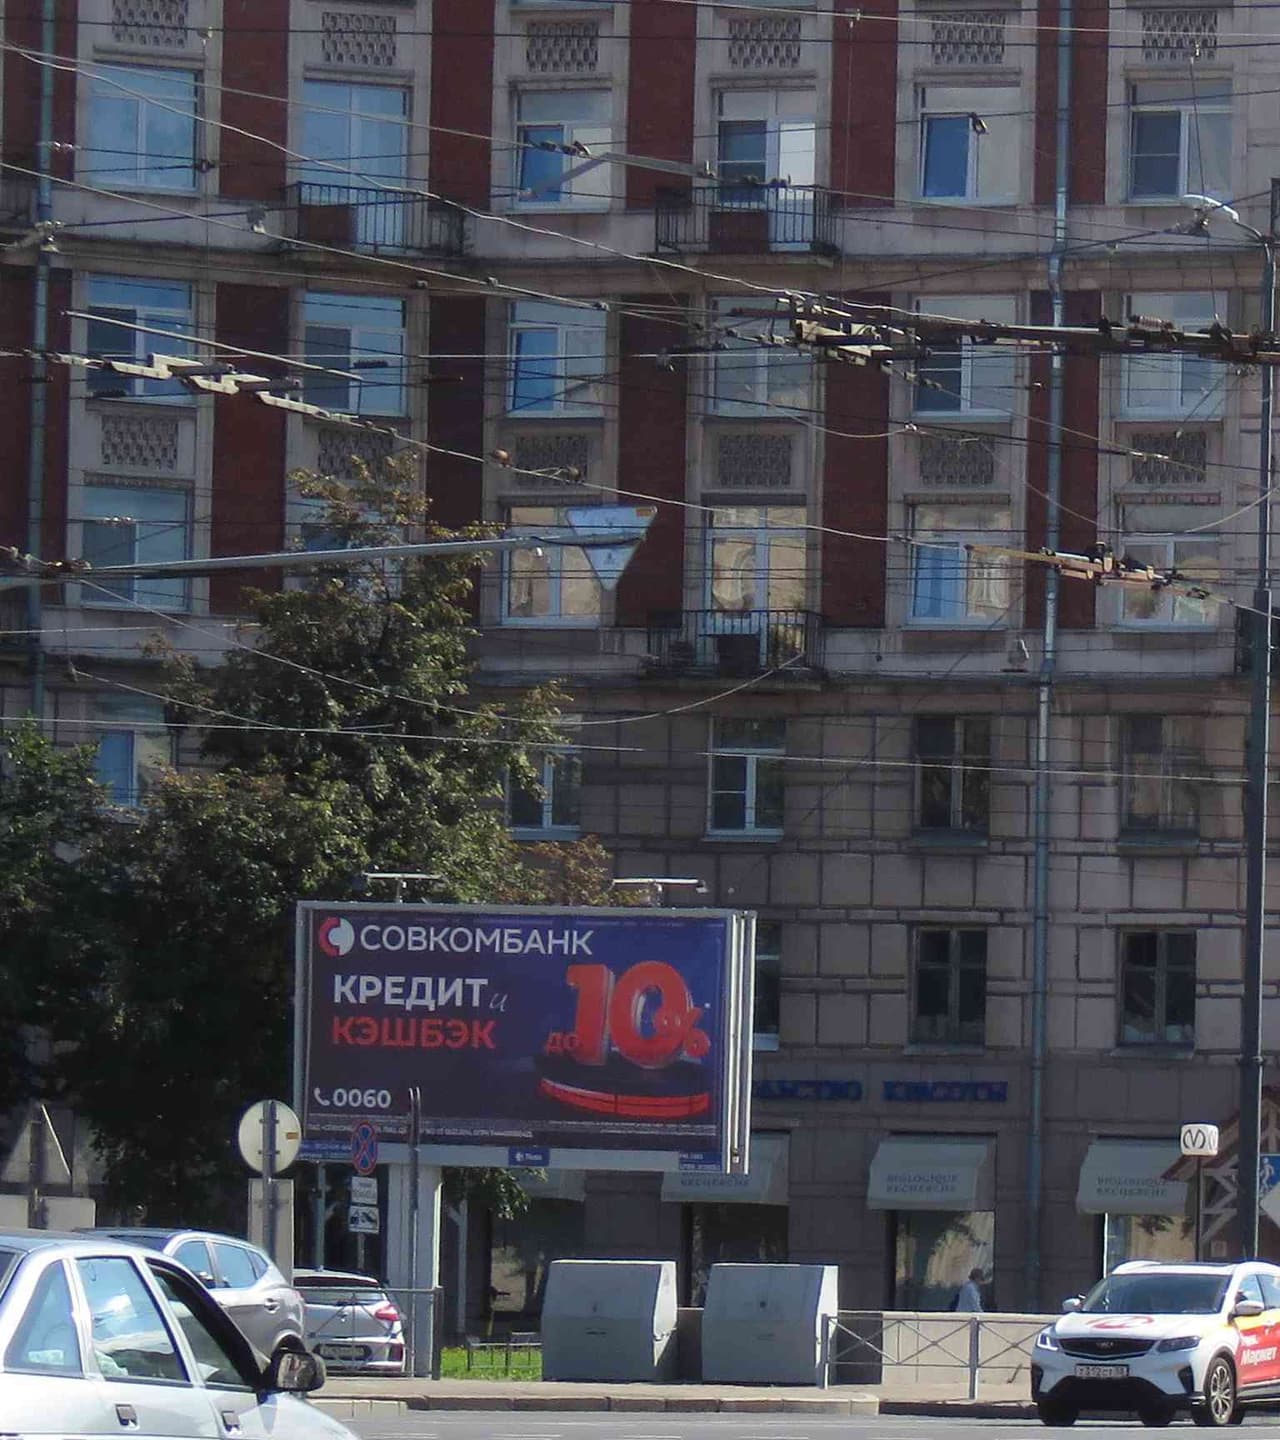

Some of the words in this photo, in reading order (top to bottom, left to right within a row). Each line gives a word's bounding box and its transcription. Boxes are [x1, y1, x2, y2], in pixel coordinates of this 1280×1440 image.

[360, 924, 594, 956] СОВКОМБАНК
[334, 974, 489, 1012] КРЕДИТ
[332, 1016, 497, 1049] КЭШБЭК
[331, 1088, 392, 1108] 0060
